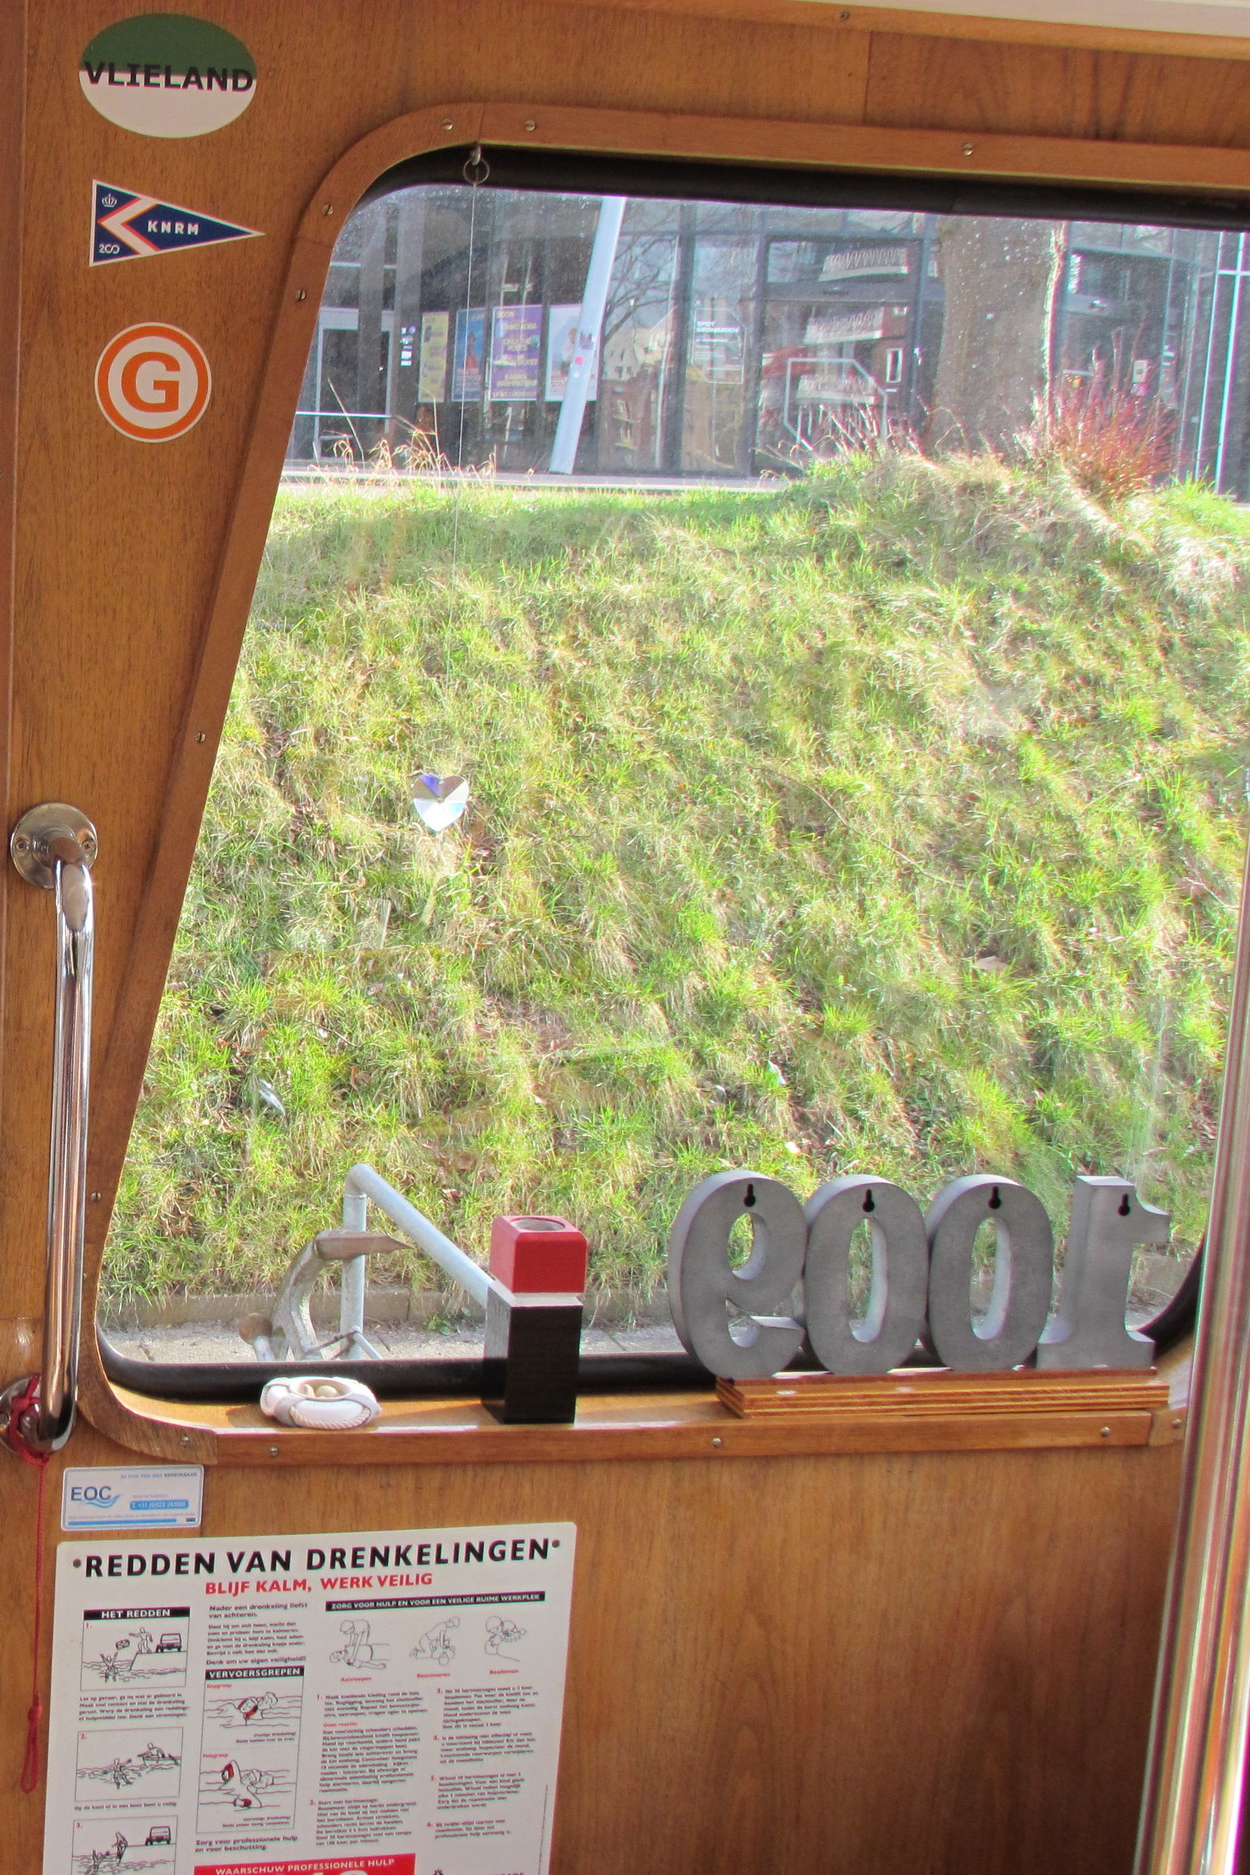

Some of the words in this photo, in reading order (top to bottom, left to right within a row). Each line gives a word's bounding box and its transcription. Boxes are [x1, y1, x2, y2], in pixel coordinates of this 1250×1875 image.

[84, 61, 254, 92] VLIELAND
[147, 220, 199, 236] KNRM
[121, 351, 181, 413] G
[71, 1485, 112, 1502] EOC
[85, 1551, 214, 1578] REDDEN
[226, 1548, 290, 1572] VAN
[306, 1539, 550, 1569] DRENKELINGEN
[205, 1581, 252, 1596] BLIJF
[256, 1578, 316, 1594] KALM,
[320, 1575, 373, 1590] WERK
[377, 1573, 433, 1588] VEILIG
[501, 1594, 540, 1602] WERKPLEK
[100, 1609, 124, 1619] HET
[126, 1608, 172, 1618] REDDEN
[249, 1603, 288, 1611] drenkeling
[209, 1668, 300, 1678] VERVOERSGREPEN
[233, 1836, 281, 1845] professionele
[215, 1865, 285, 1875] WAARSCHUW
[287, 1860, 365, 1871] PROFESSIONELE
[368, 1859, 395, 1867] HULP
